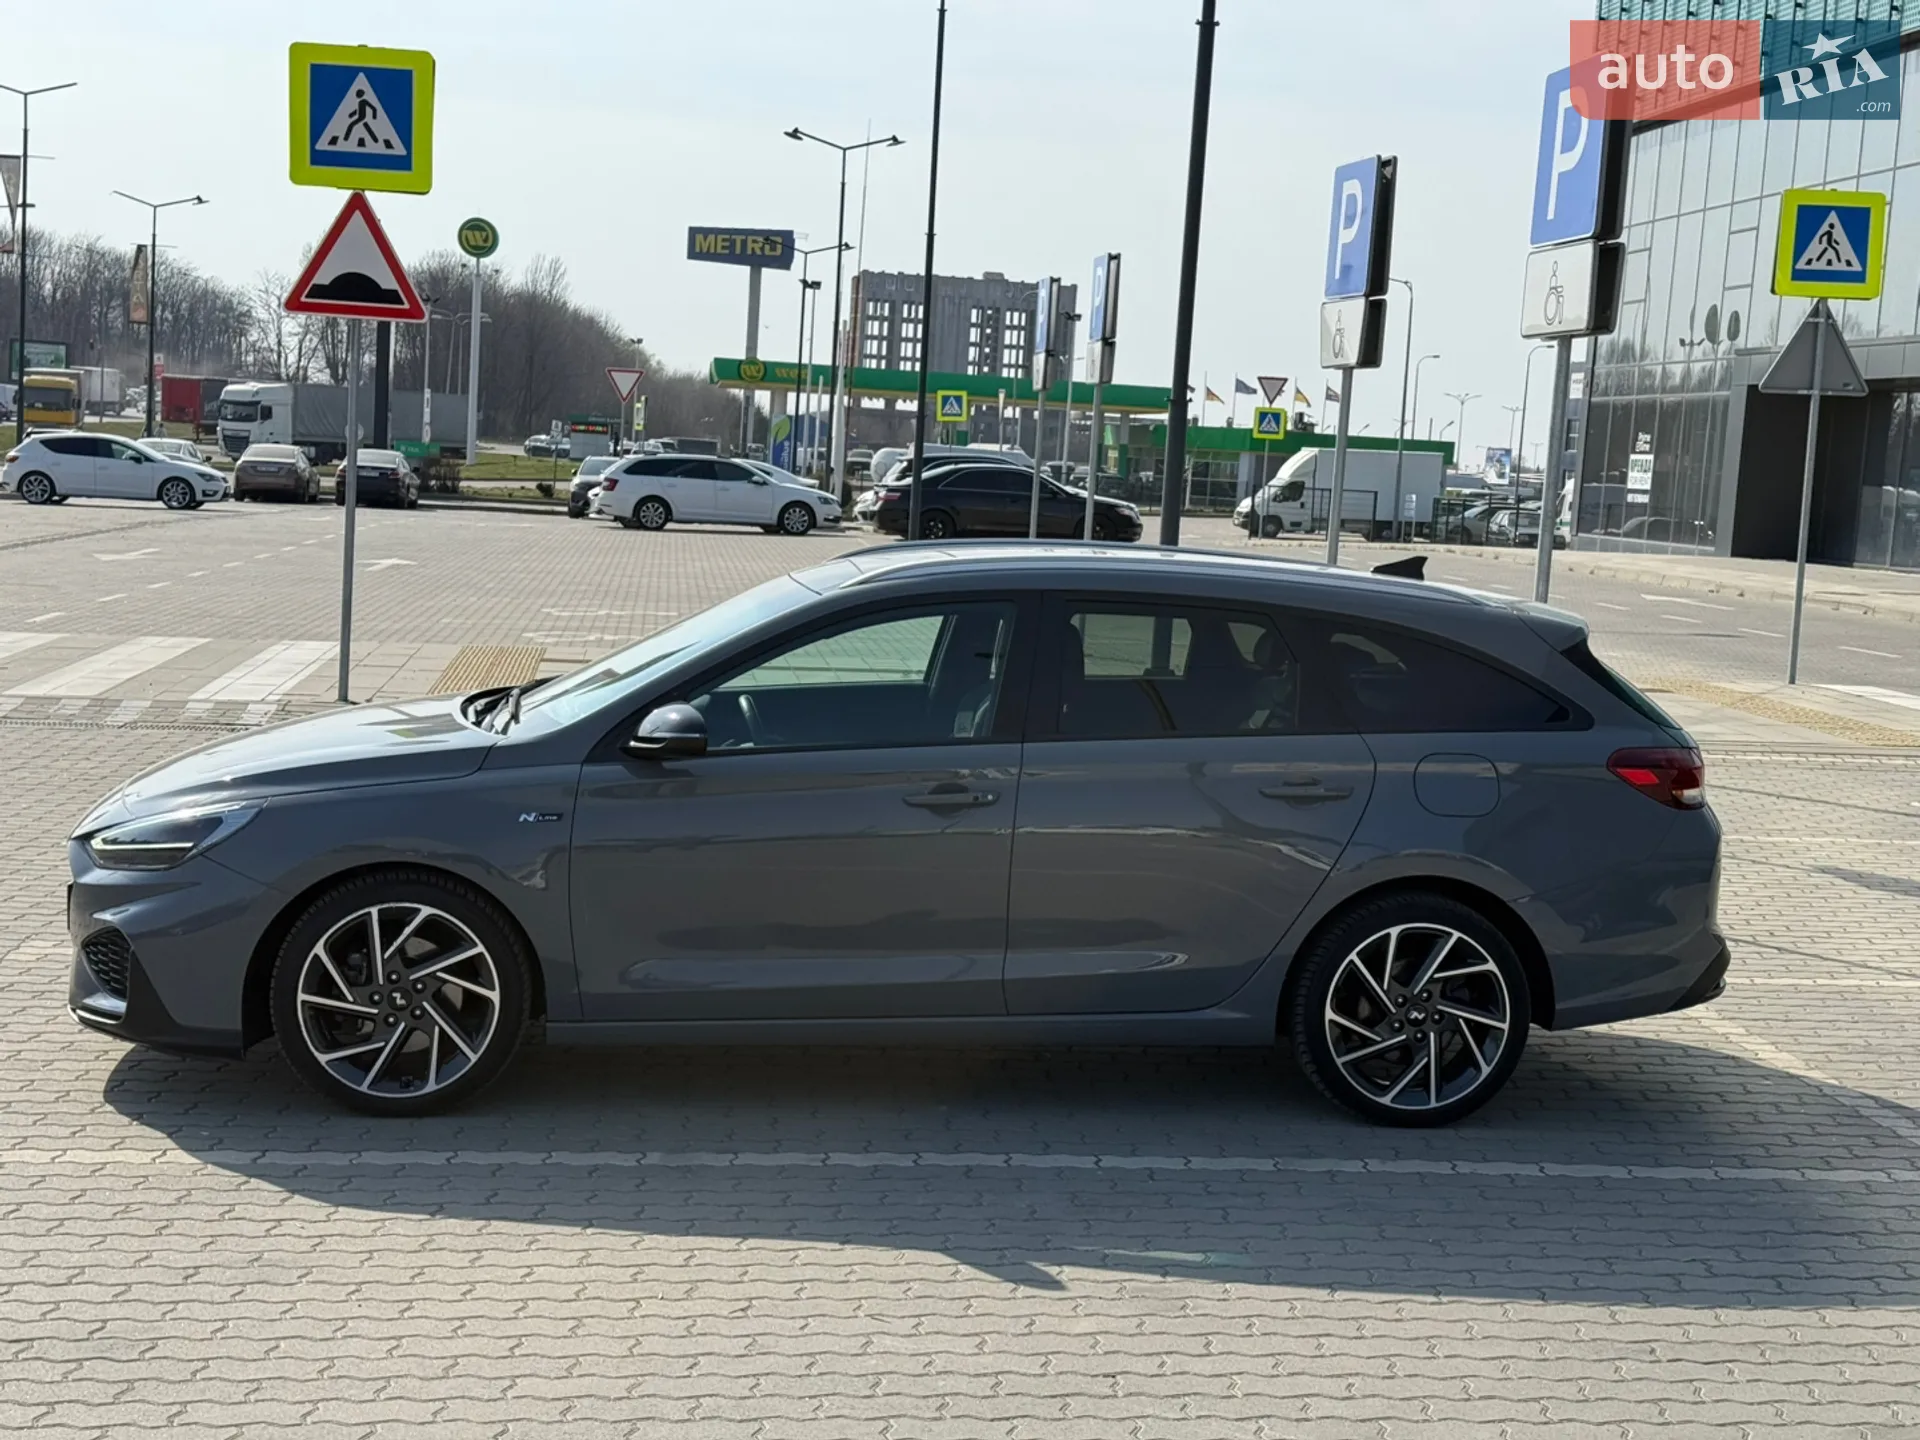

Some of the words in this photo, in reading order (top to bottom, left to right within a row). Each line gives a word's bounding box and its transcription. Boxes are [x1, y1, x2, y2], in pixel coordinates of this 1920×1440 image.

[1547, 86, 1589, 221] P
[695, 233, 782, 255] METRO
[1335, 179, 1362, 280] P
[1093, 266, 1103, 330] P
